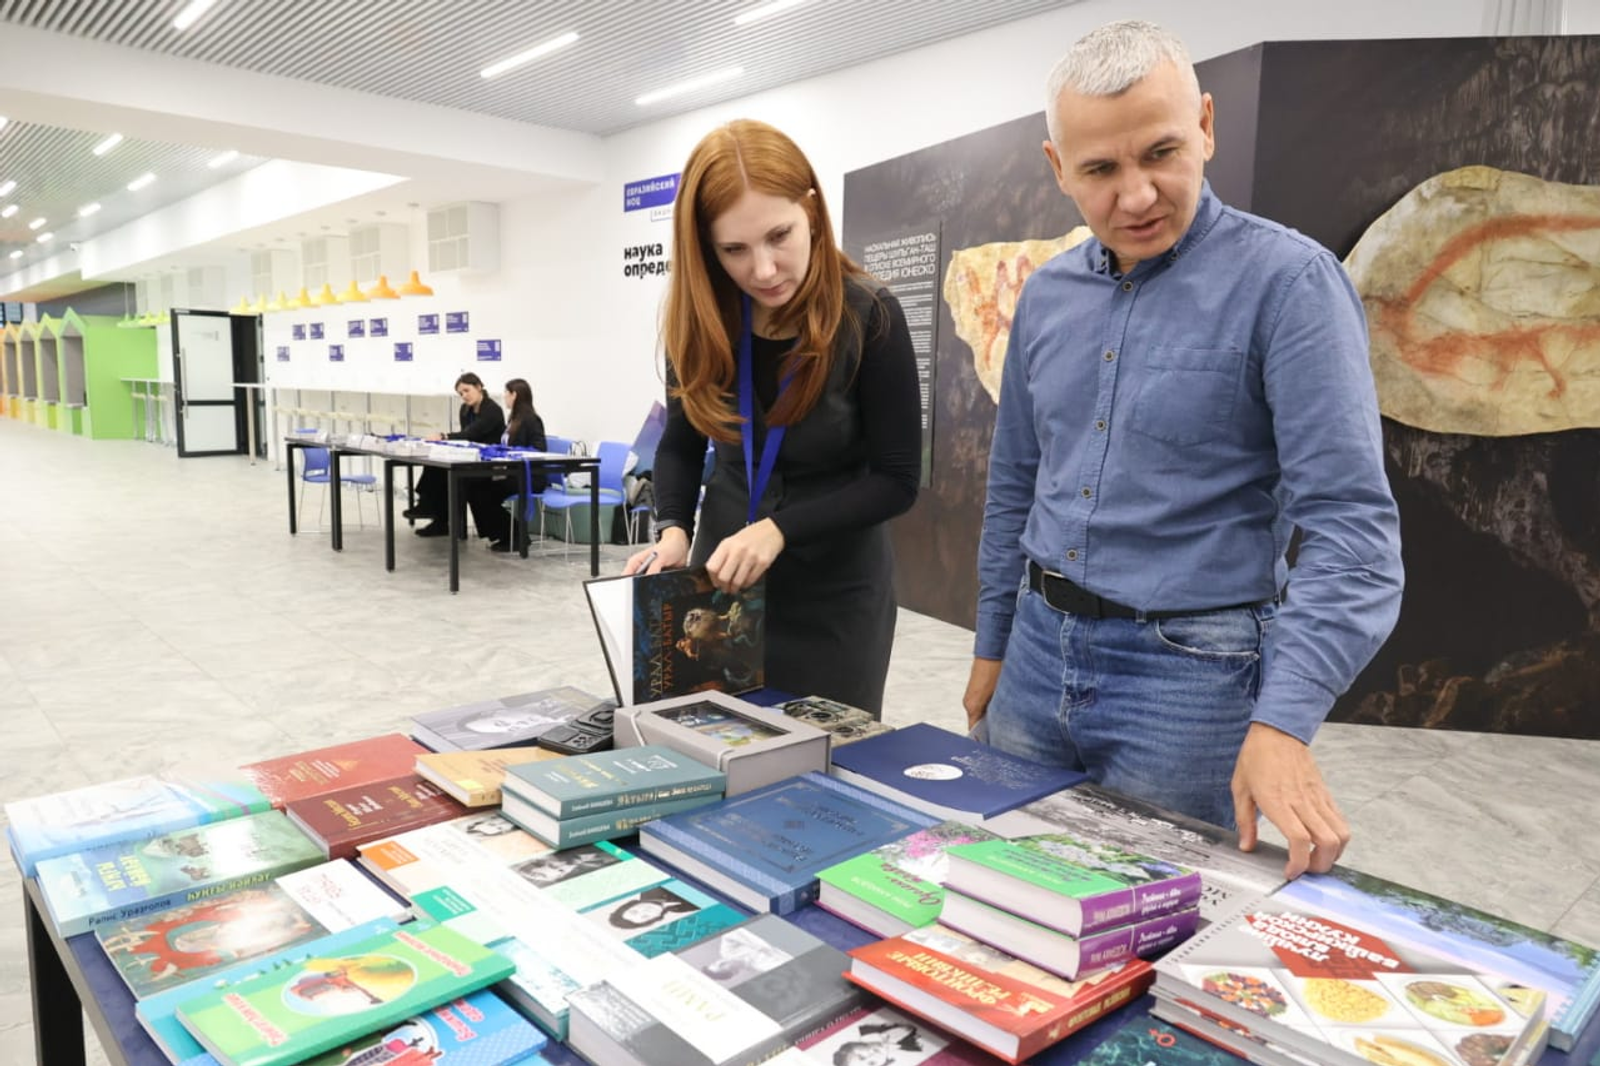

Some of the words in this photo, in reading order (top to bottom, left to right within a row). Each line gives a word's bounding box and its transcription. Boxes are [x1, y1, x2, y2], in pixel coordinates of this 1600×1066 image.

[626, 178, 675, 197] ЕВРАЗИЙСКИЙ
[624, 243, 663, 262] наука
[624, 260, 672, 280] опреде
[900, 263, 936, 278] ЮНЕСКО
[651, 653, 662, 698] УРАЛ
[886, 950, 997, 1005] ФРОНТОВЫЕ
[913, 952, 1012, 1000] РЕЛИКВИИ
